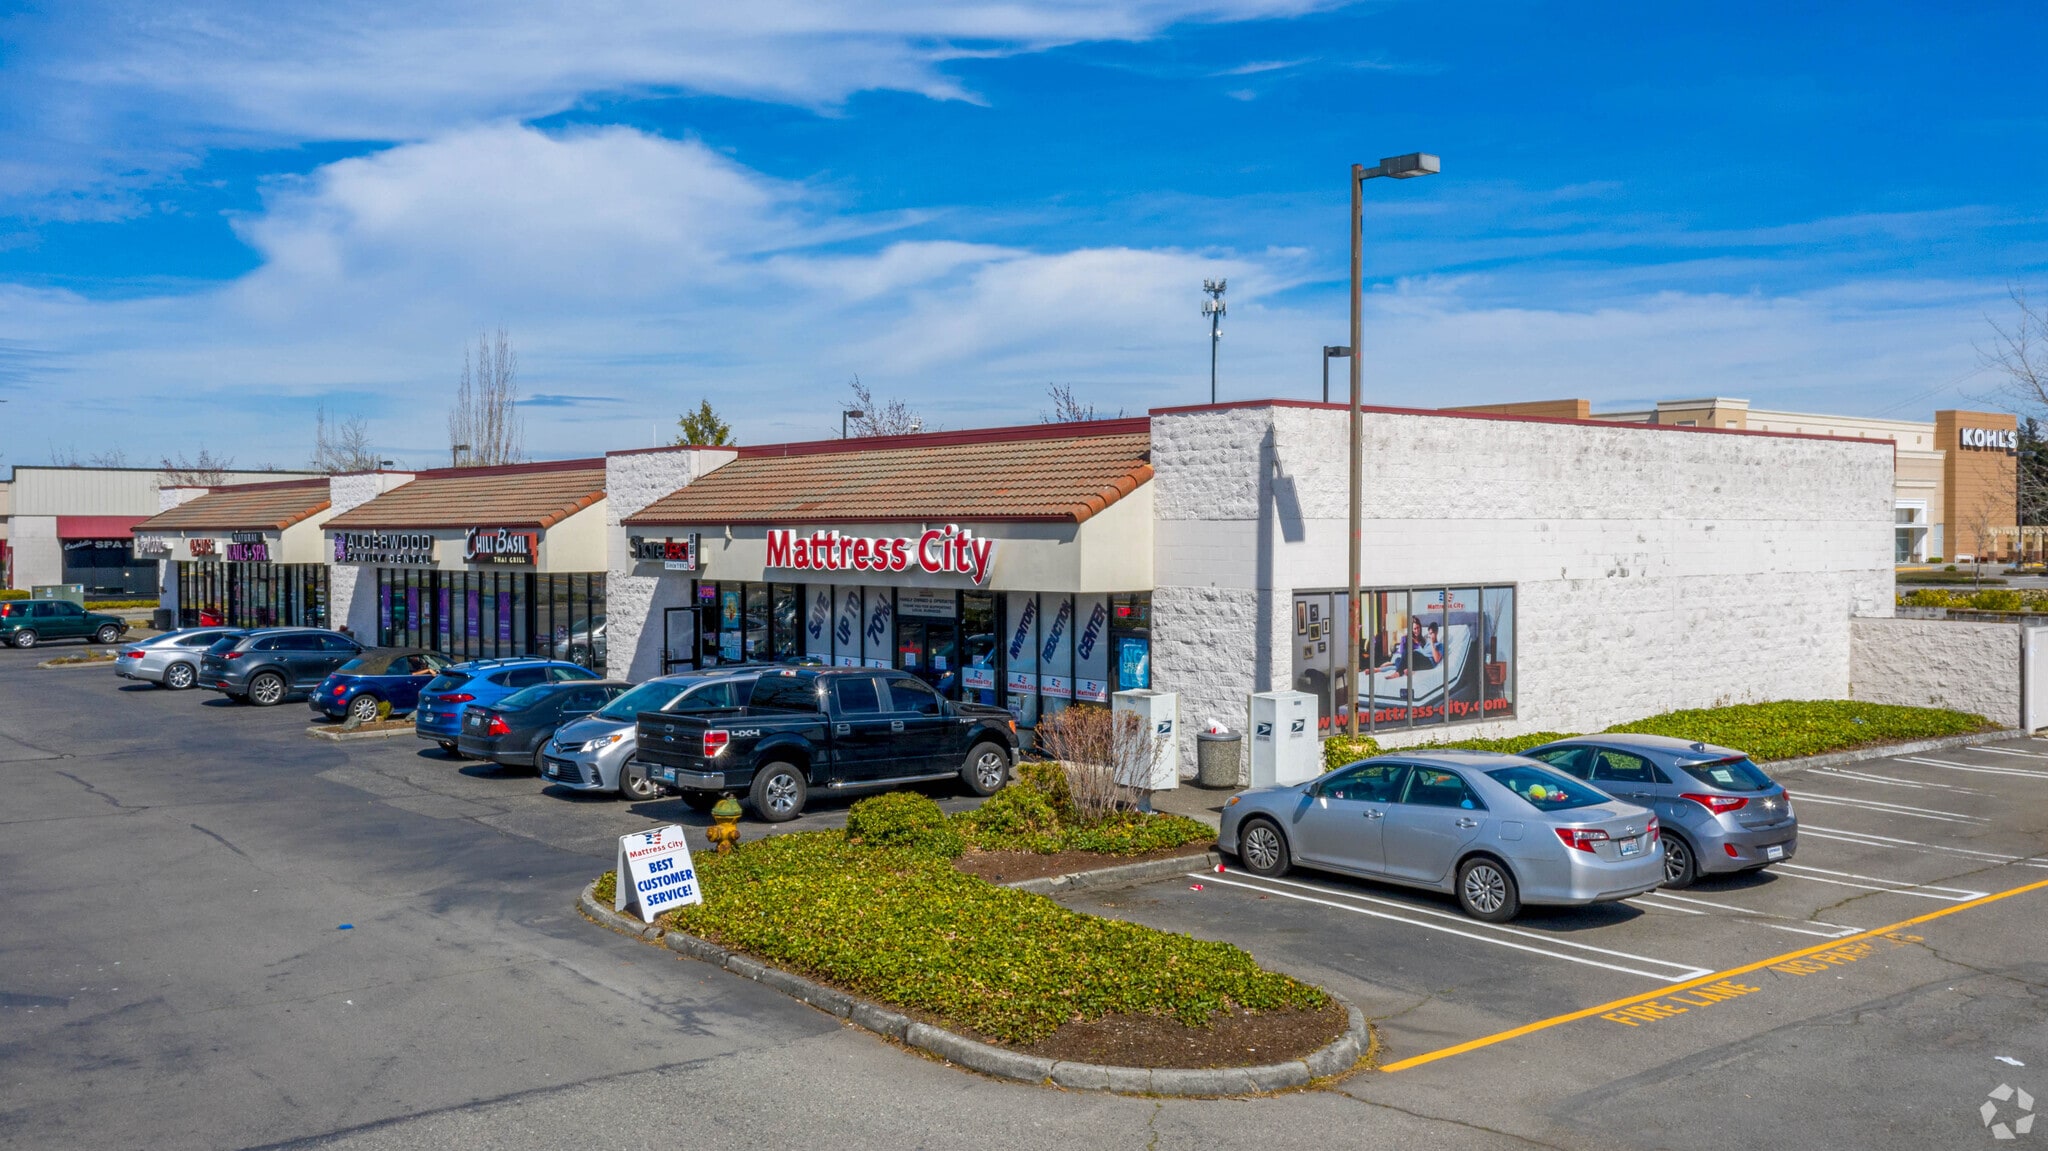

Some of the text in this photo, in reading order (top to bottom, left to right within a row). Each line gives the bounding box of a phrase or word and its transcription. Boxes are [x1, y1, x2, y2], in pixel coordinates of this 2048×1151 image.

[1962, 428, 2018, 449] KOHL'S
[227, 544, 248, 560] NAILS
[252, 544, 267, 560] SPA
[347, 534, 430, 550] ALDERWOOD
[464, 526, 527, 559] CHILI BASIL
[766, 523, 993, 585] Mattress City
[347, 554, 430, 564] FAMILY DENTAL
[808, 591, 830, 640] SAVE
[836, 591, 861, 646] UP TO
[1009, 597, 1036, 660] INVENTORY
[1041, 598, 1071, 664] REDUCTION
[1077, 601, 1107, 660] CENTER
[629, 840, 684, 858] Mattress City
[648, 857, 673, 874] BEST
[637, 869, 694, 892] CUSTOMER
[646, 884, 693, 907] SERVICE!
[1600, 980, 1761, 1027] FIRE LANE
